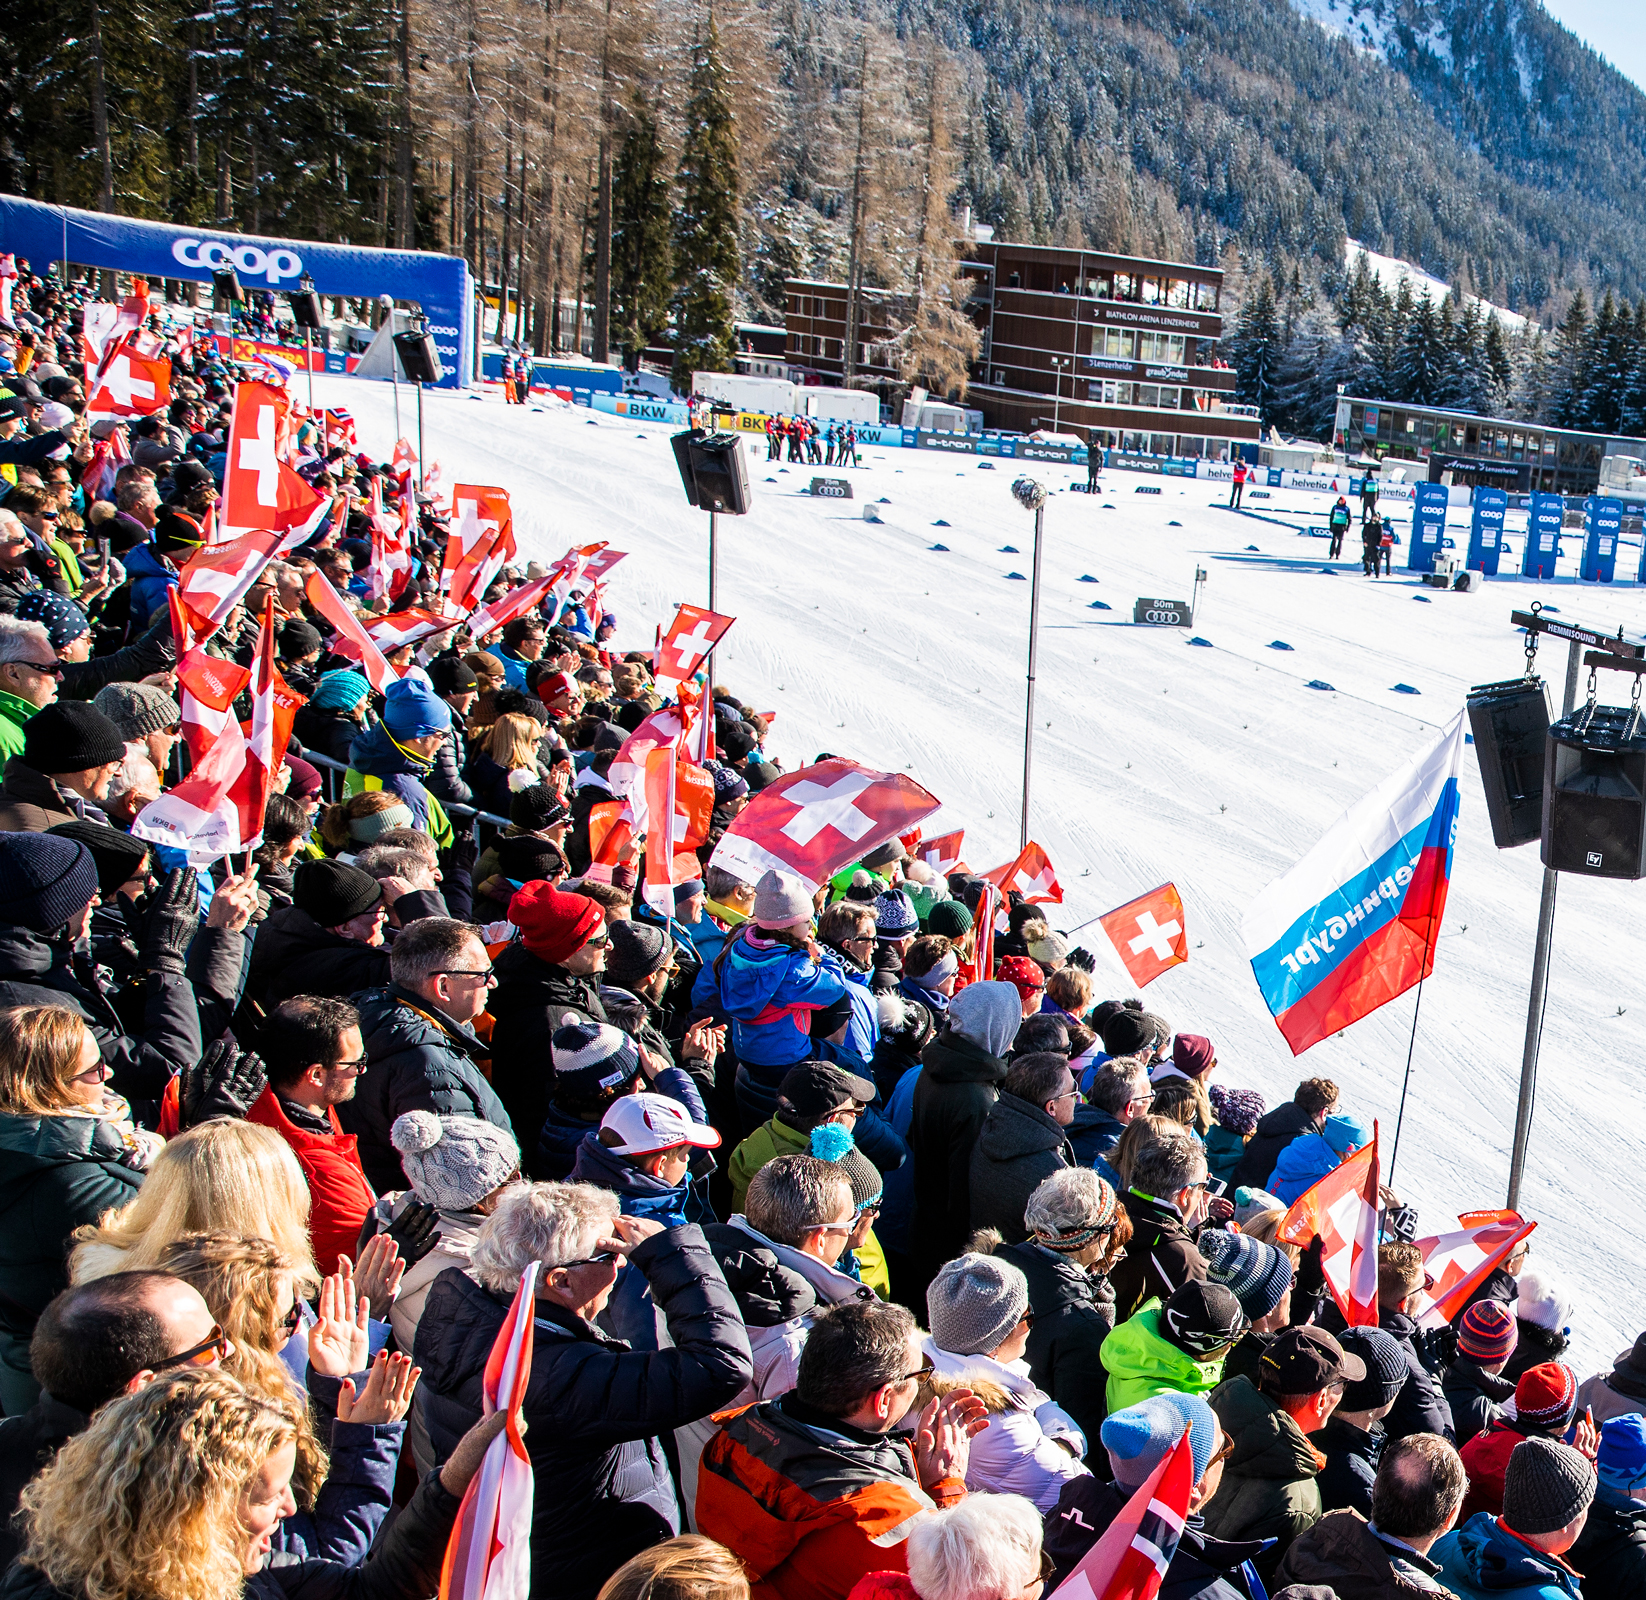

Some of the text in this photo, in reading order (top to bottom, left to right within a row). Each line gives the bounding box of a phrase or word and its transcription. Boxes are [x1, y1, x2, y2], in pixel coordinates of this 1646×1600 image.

[172, 238, 303, 284] coop
[1105, 310, 1200, 329] BIATHLON ARENA LENZERHEIDE
[428, 325, 458, 337] coop
[436, 345, 457, 356] oop
[1094, 360, 1133, 371] Lenzerheide
[630, 404, 666, 418] BKW
[742, 417, 766, 430] BK
[855, 429, 881, 442] KW
[926, 438, 972, 450] e-tron
[1024, 449, 1067, 460] e-tron
[1117, 459, 1159, 470] e-tron
[1208, 468, 1233, 479] helve
[1485, 466, 1518, 475] Lenzerheide
[1291, 477, 1328, 490] helvetia
[1421, 506, 1445, 516] coop
[1480, 510, 1503, 520] coop
[1538, 515, 1560, 525] coop
[1597, 519, 1619, 529] coop
[1313, 528, 1333, 536] coo
[1153, 600, 1174, 609] 50m
[1547, 624, 1597, 645] HEMMISOUND
